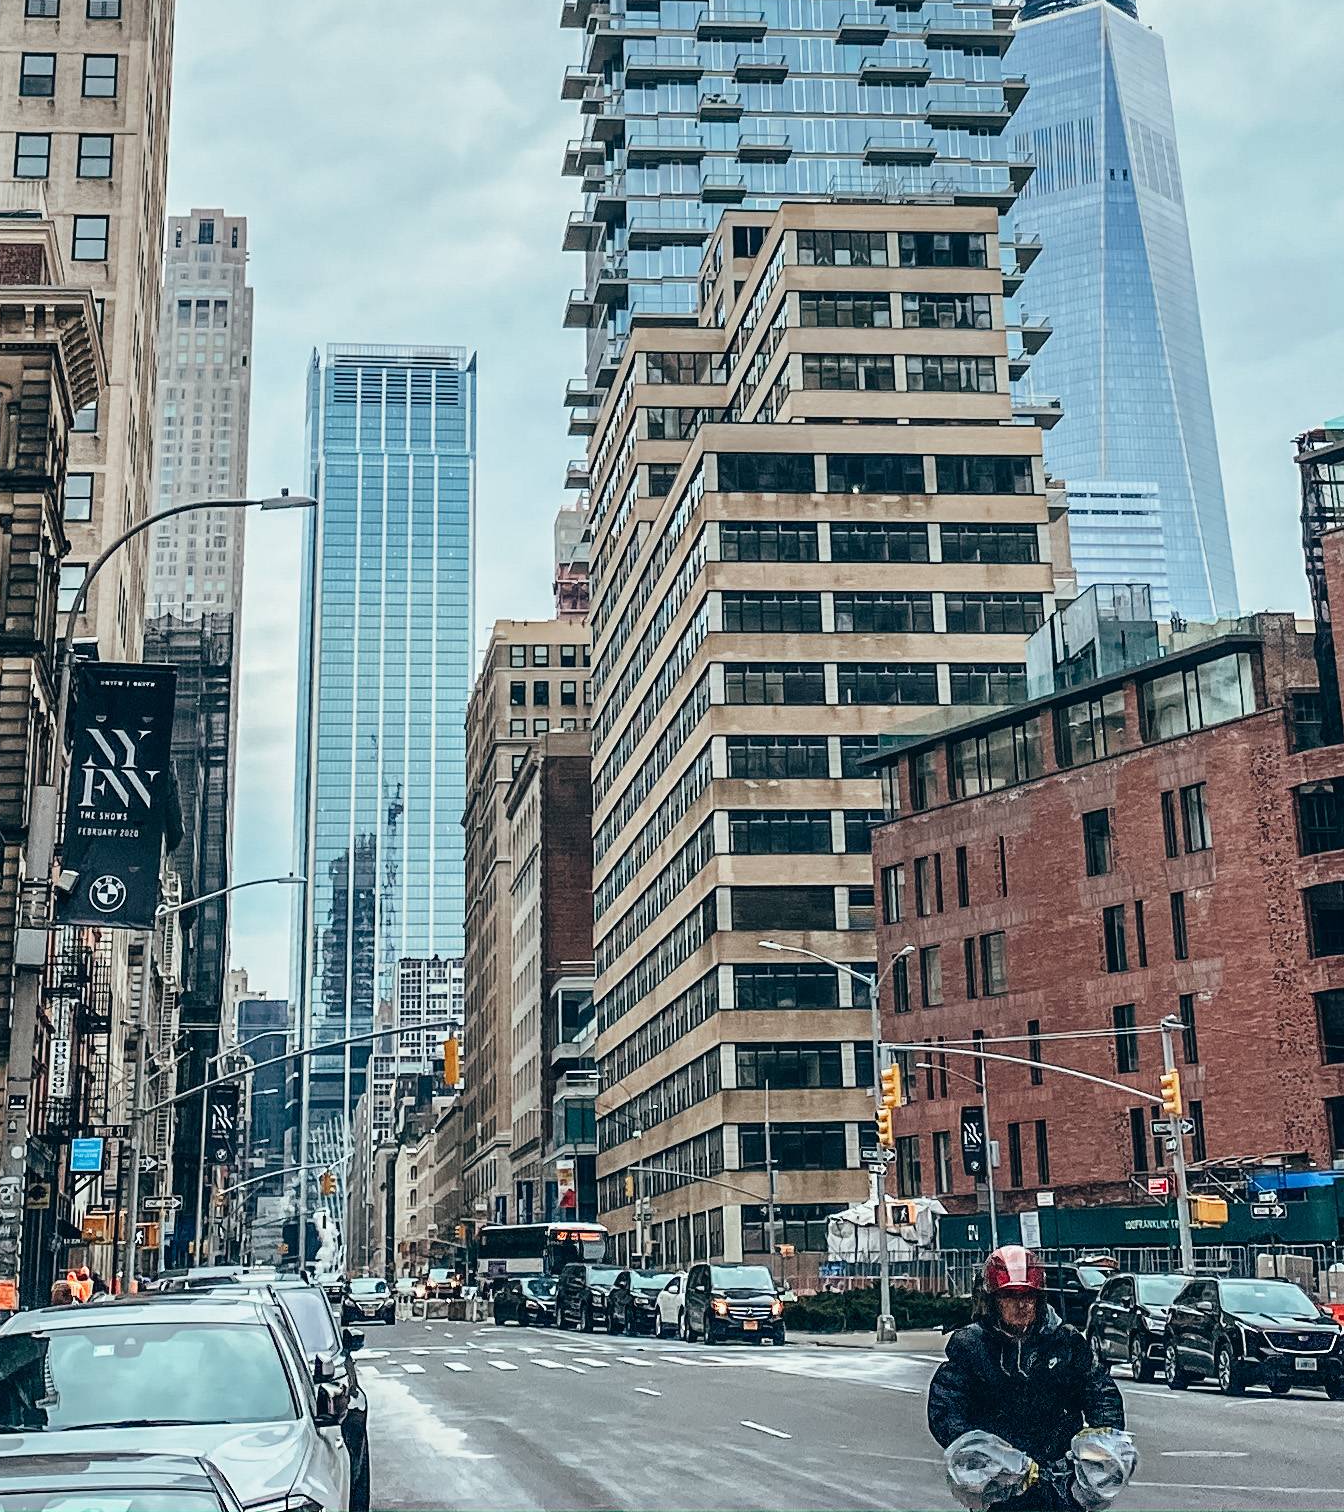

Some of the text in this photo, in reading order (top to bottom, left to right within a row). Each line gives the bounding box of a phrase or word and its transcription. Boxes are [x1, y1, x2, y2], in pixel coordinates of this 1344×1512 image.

[80, 810, 128, 822] THE SHOWS
[77, 827, 139, 839] FEBRUARY 2020
